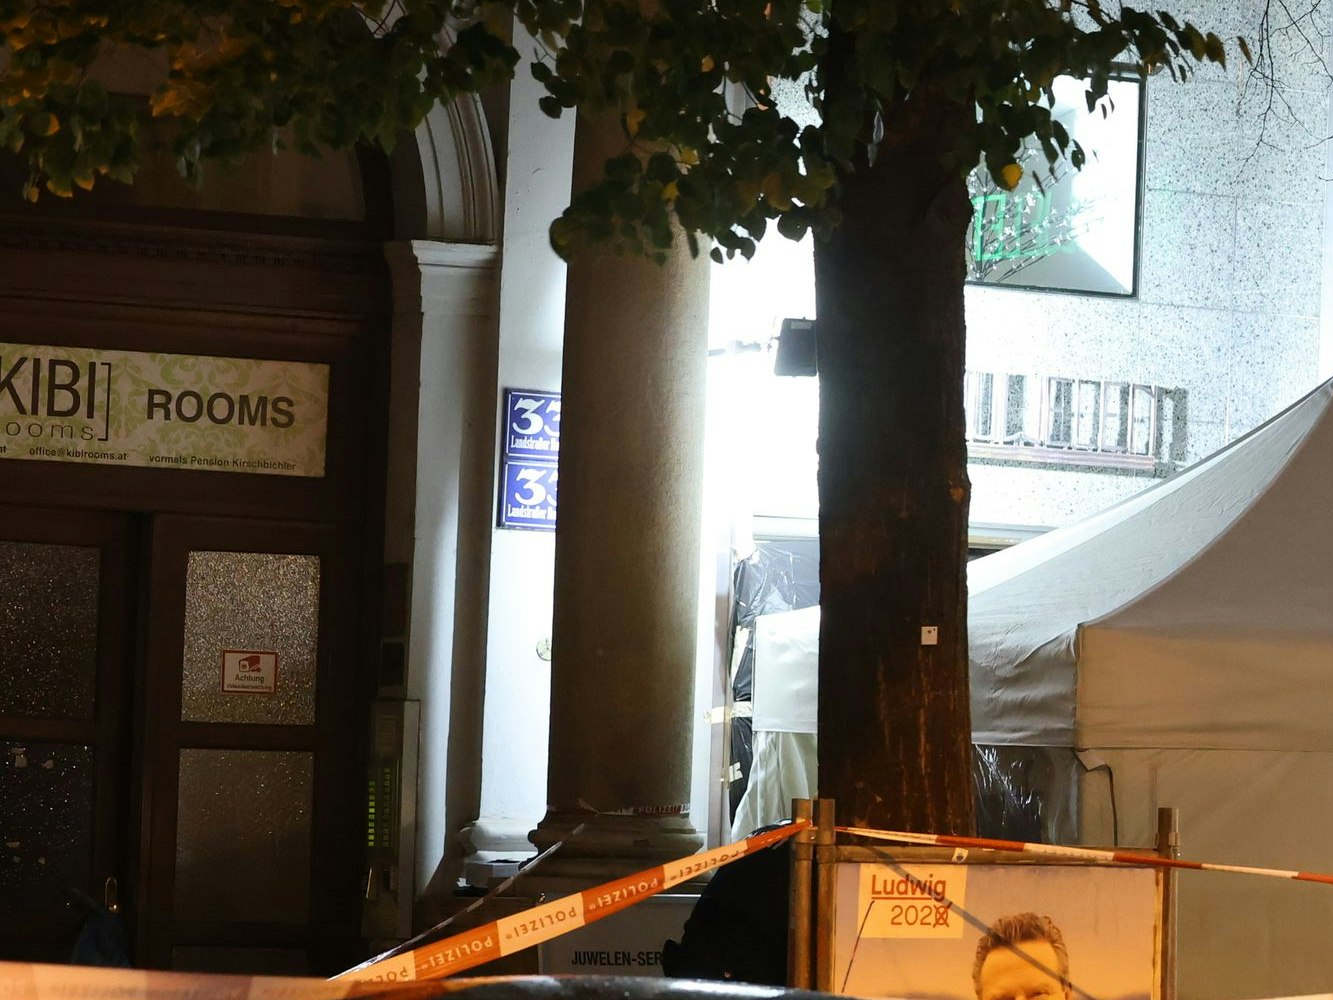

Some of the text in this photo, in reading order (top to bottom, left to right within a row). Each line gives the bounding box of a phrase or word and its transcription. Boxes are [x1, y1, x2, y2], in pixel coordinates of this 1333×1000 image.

[147, 388, 296, 428] ROOMS
[5, 420, 94, 441] ooms
[149, 454, 188, 465] vormals
[190, 455, 230, 467] Pension
[234, 673, 265, 685] Achtung
[597, 877, 659, 908] POLIZEI
[871, 874, 947, 902] Ludwig
[512, 905, 577, 938] POLIZEI
[427, 937, 494, 968] POLIZEI
